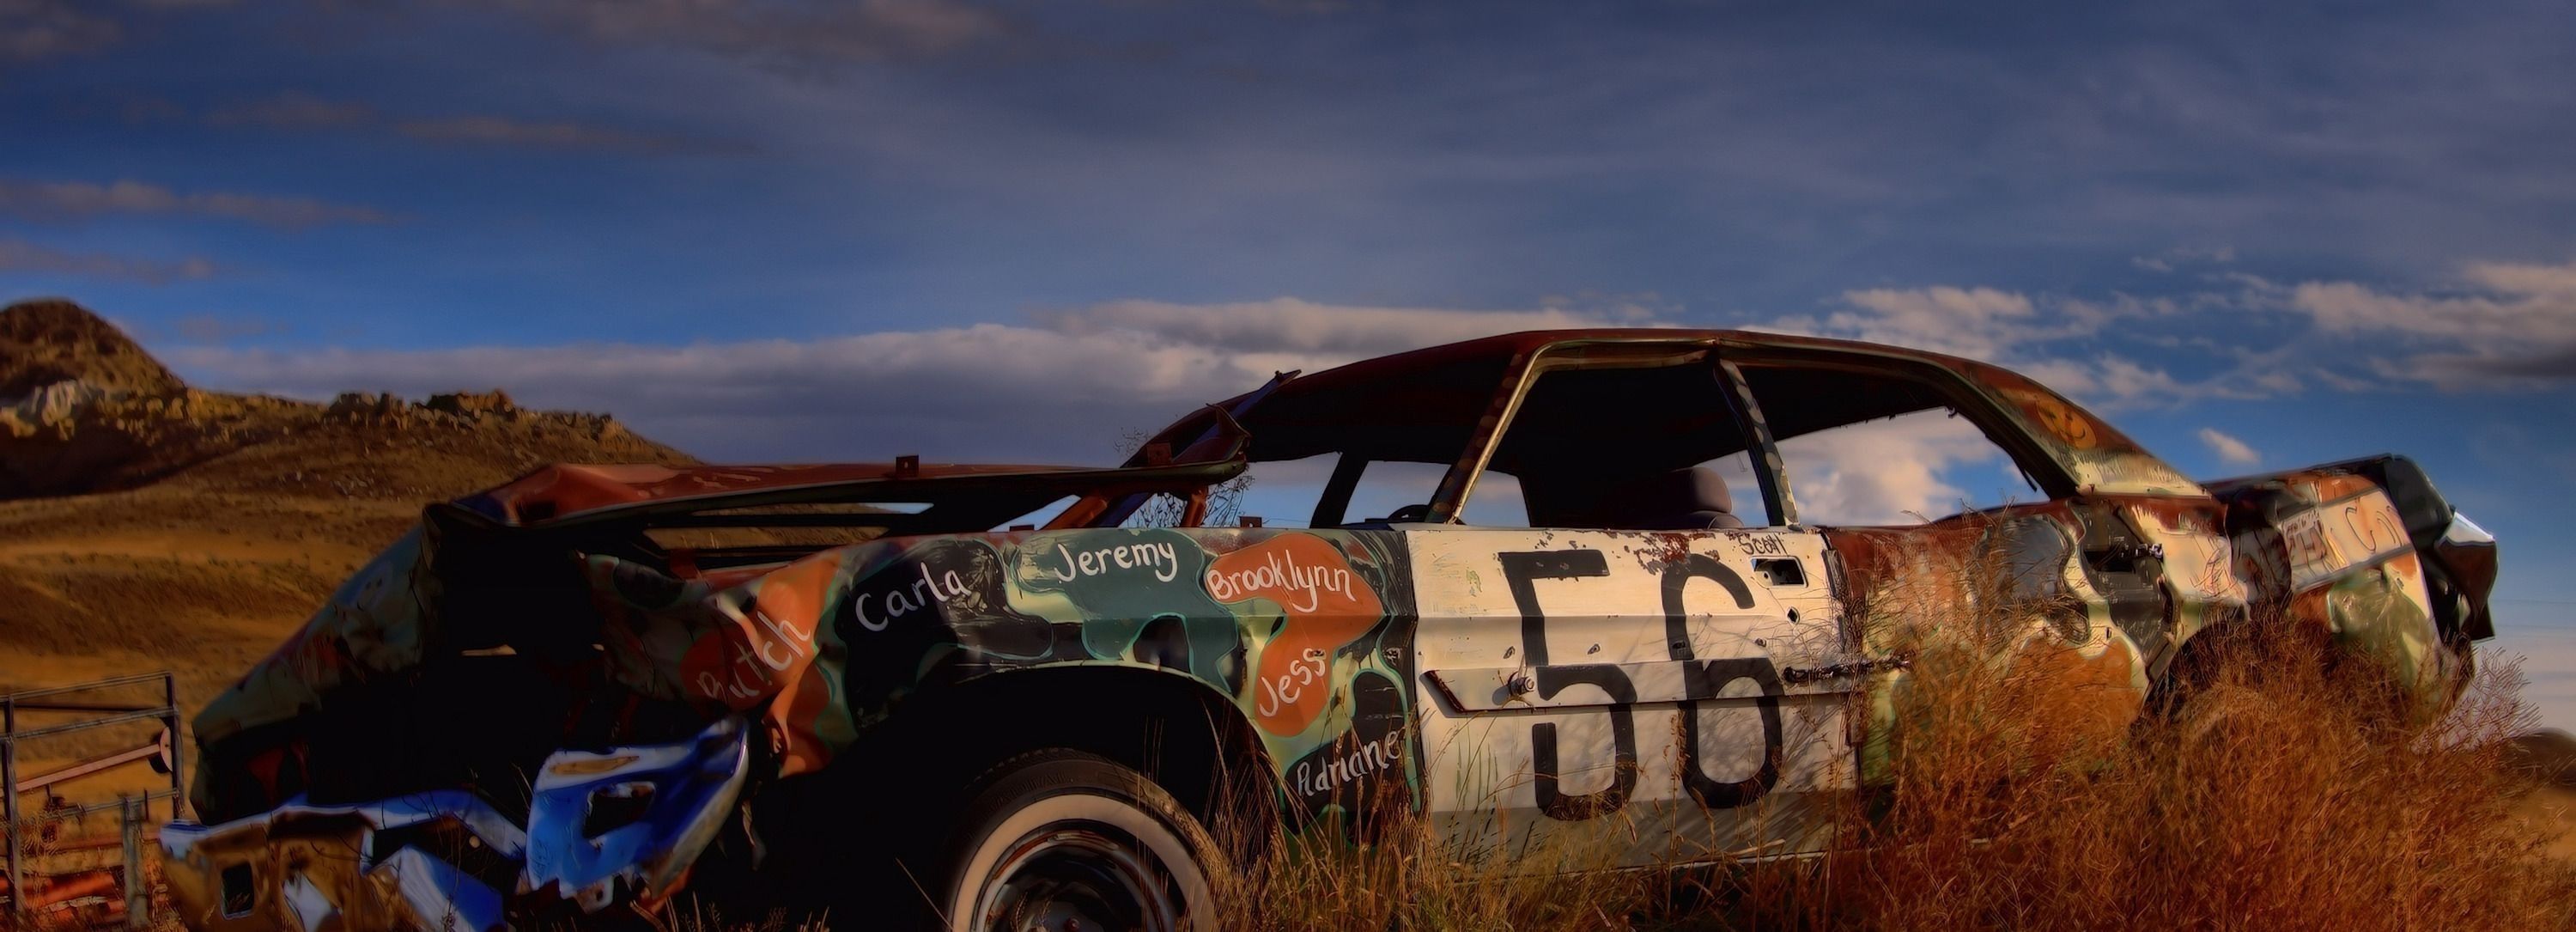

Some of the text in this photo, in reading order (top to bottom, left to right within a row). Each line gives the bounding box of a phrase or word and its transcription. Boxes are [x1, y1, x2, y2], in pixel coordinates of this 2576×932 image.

[1054, 542, 1177, 582] Jeremy
[1204, 550, 1356, 612] Brooklynn
[855, 563, 971, 631] Carla
[1259, 648, 1326, 717] Jess
[1498, 549, 1785, 820] 56
[1297, 731, 1401, 796] Adriane
